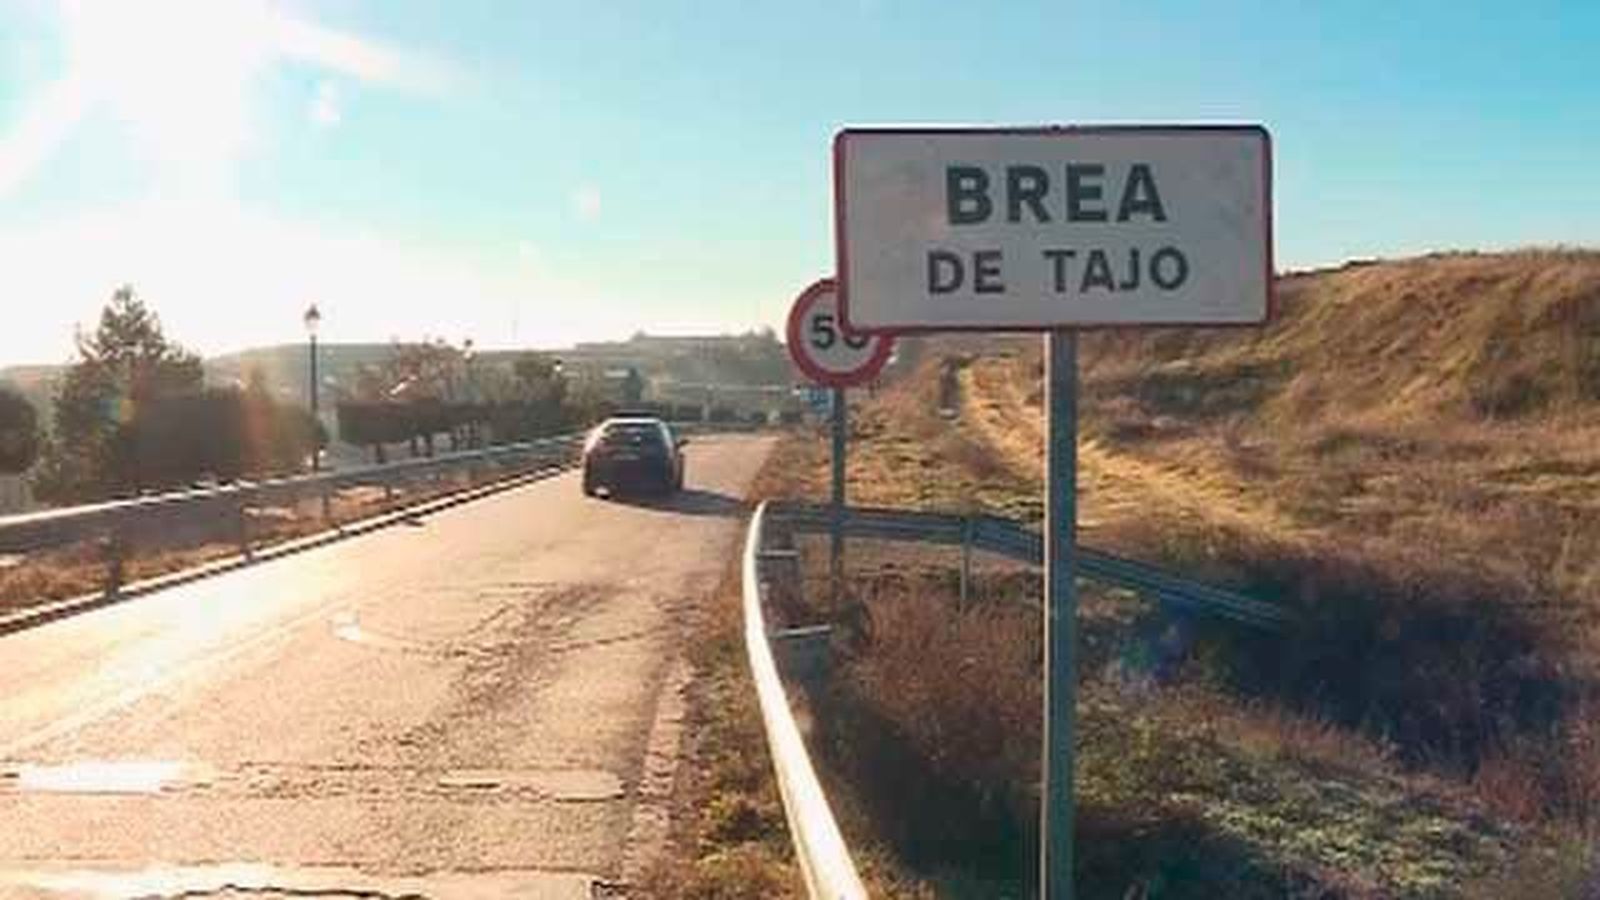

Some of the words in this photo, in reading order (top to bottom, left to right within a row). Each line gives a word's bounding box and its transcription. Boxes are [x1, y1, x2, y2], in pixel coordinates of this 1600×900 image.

[945, 164, 1168, 225] BREA
[926, 250, 1005, 295] DE
[1043, 247, 1190, 293] TAJO
